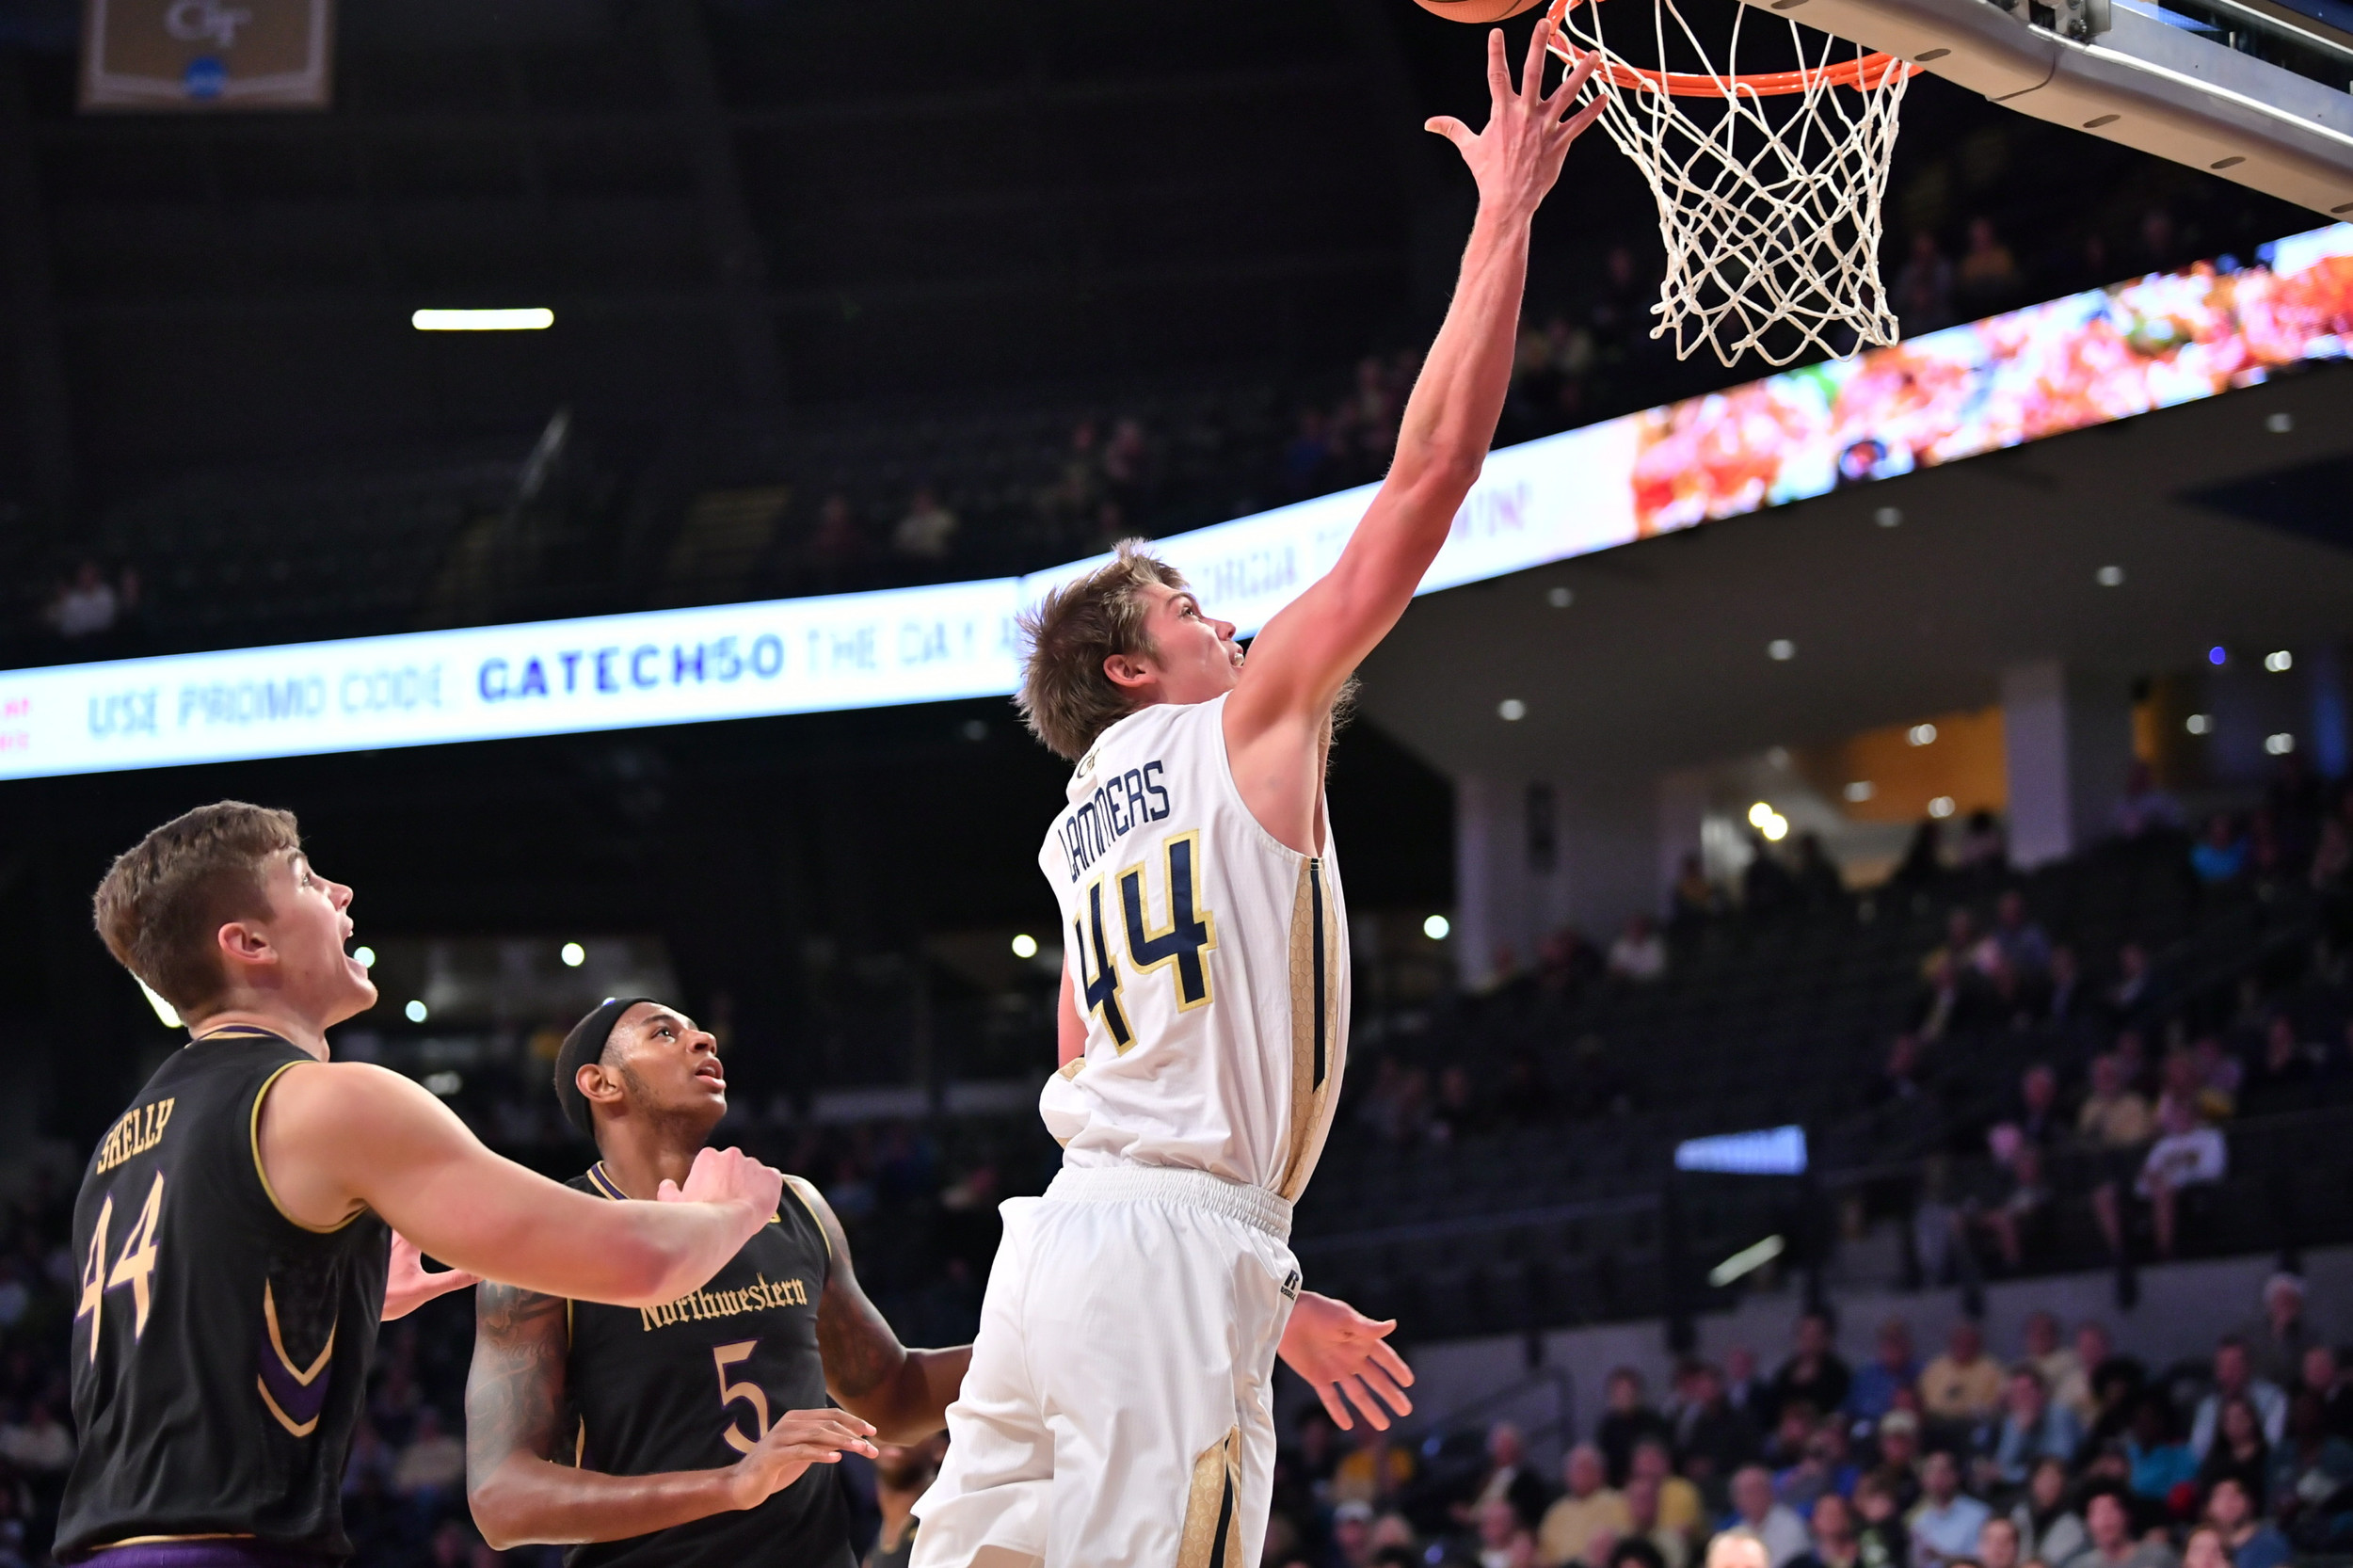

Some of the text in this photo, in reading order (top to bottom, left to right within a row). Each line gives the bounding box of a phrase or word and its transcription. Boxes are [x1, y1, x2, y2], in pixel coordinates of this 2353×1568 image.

[88, 684, 160, 739] USE
[177, 674, 327, 728] PROMO
[339, 662, 446, 713] CODE
[476, 632, 785, 703] GATECH50
[806, 622, 877, 672] THE
[1058, 760, 1170, 883] LAMMERS
[1073, 828, 1218, 1057] 44
[97, 1097, 175, 1176] SKELLY
[75, 1167, 163, 1365] 44
[640, 1272, 808, 1332] Northwestern
[712, 1337, 770, 1456] 5
